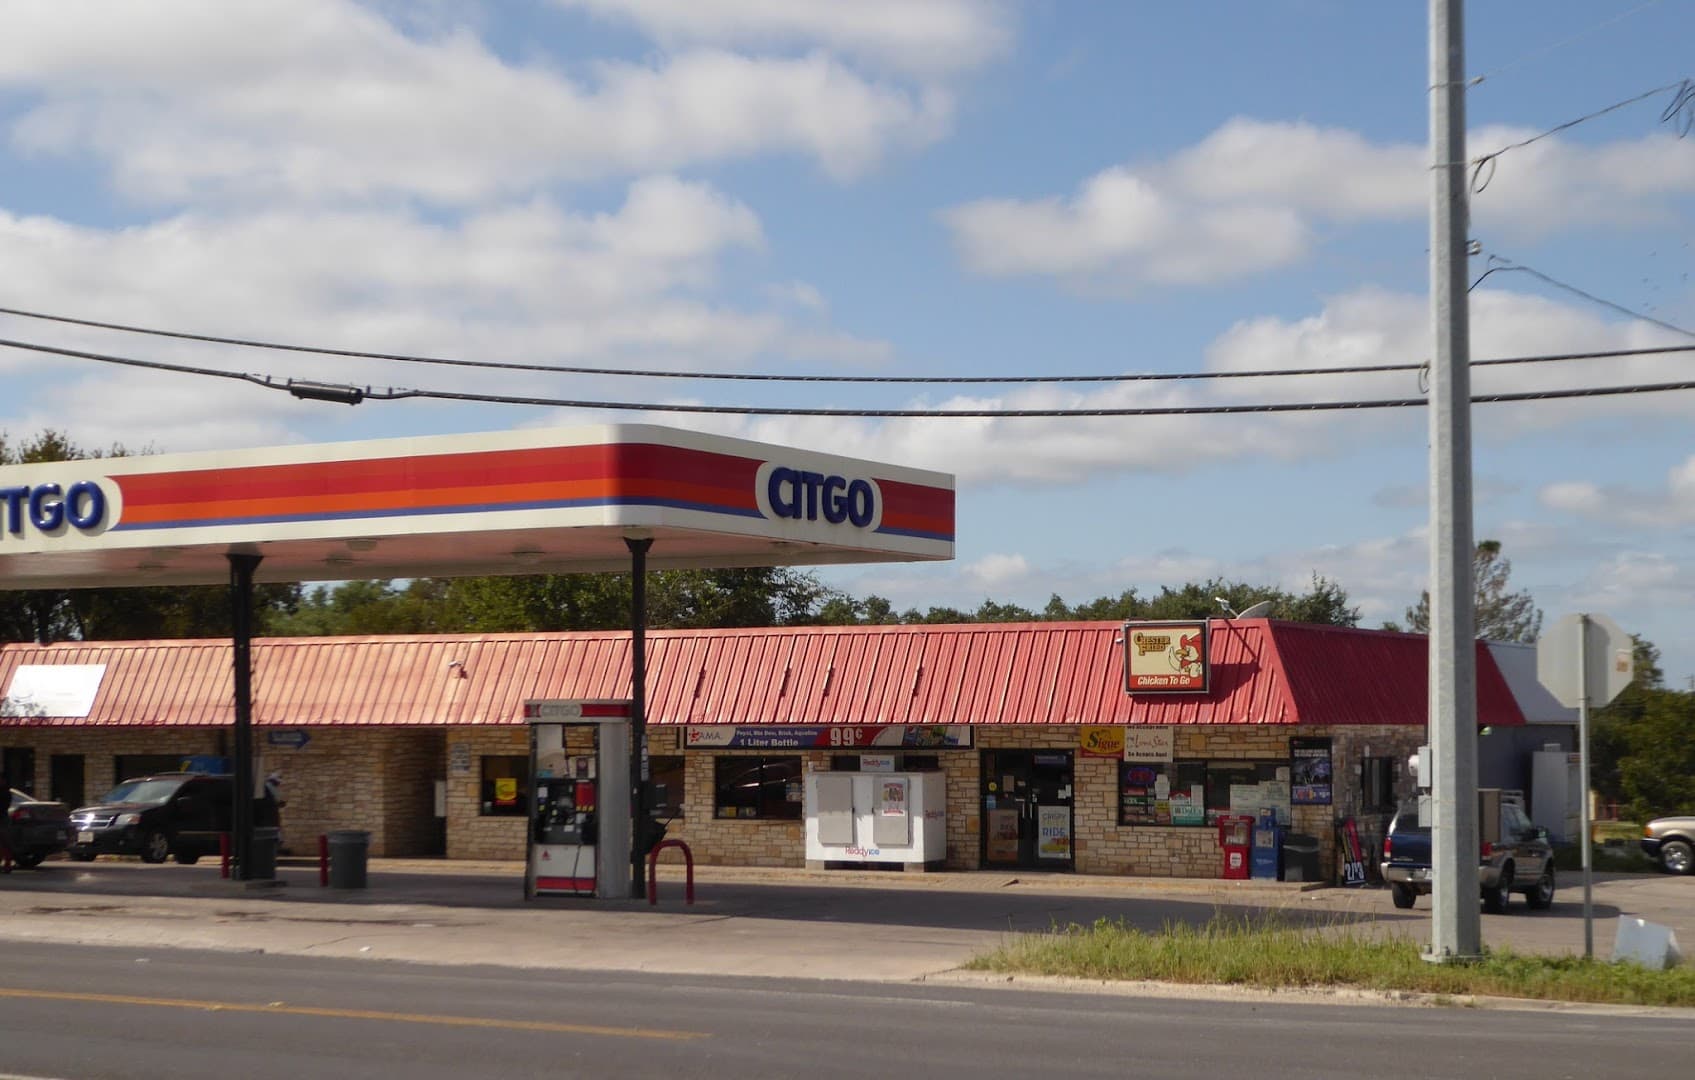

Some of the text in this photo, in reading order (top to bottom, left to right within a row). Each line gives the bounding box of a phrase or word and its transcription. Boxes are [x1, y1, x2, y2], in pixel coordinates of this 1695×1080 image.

[768, 466, 874, 528] CITGO
[1138, 675, 1190, 686] Chicken To Go
[747, 738, 769, 746] Liter
[771, 738, 799, 746] Bottle
